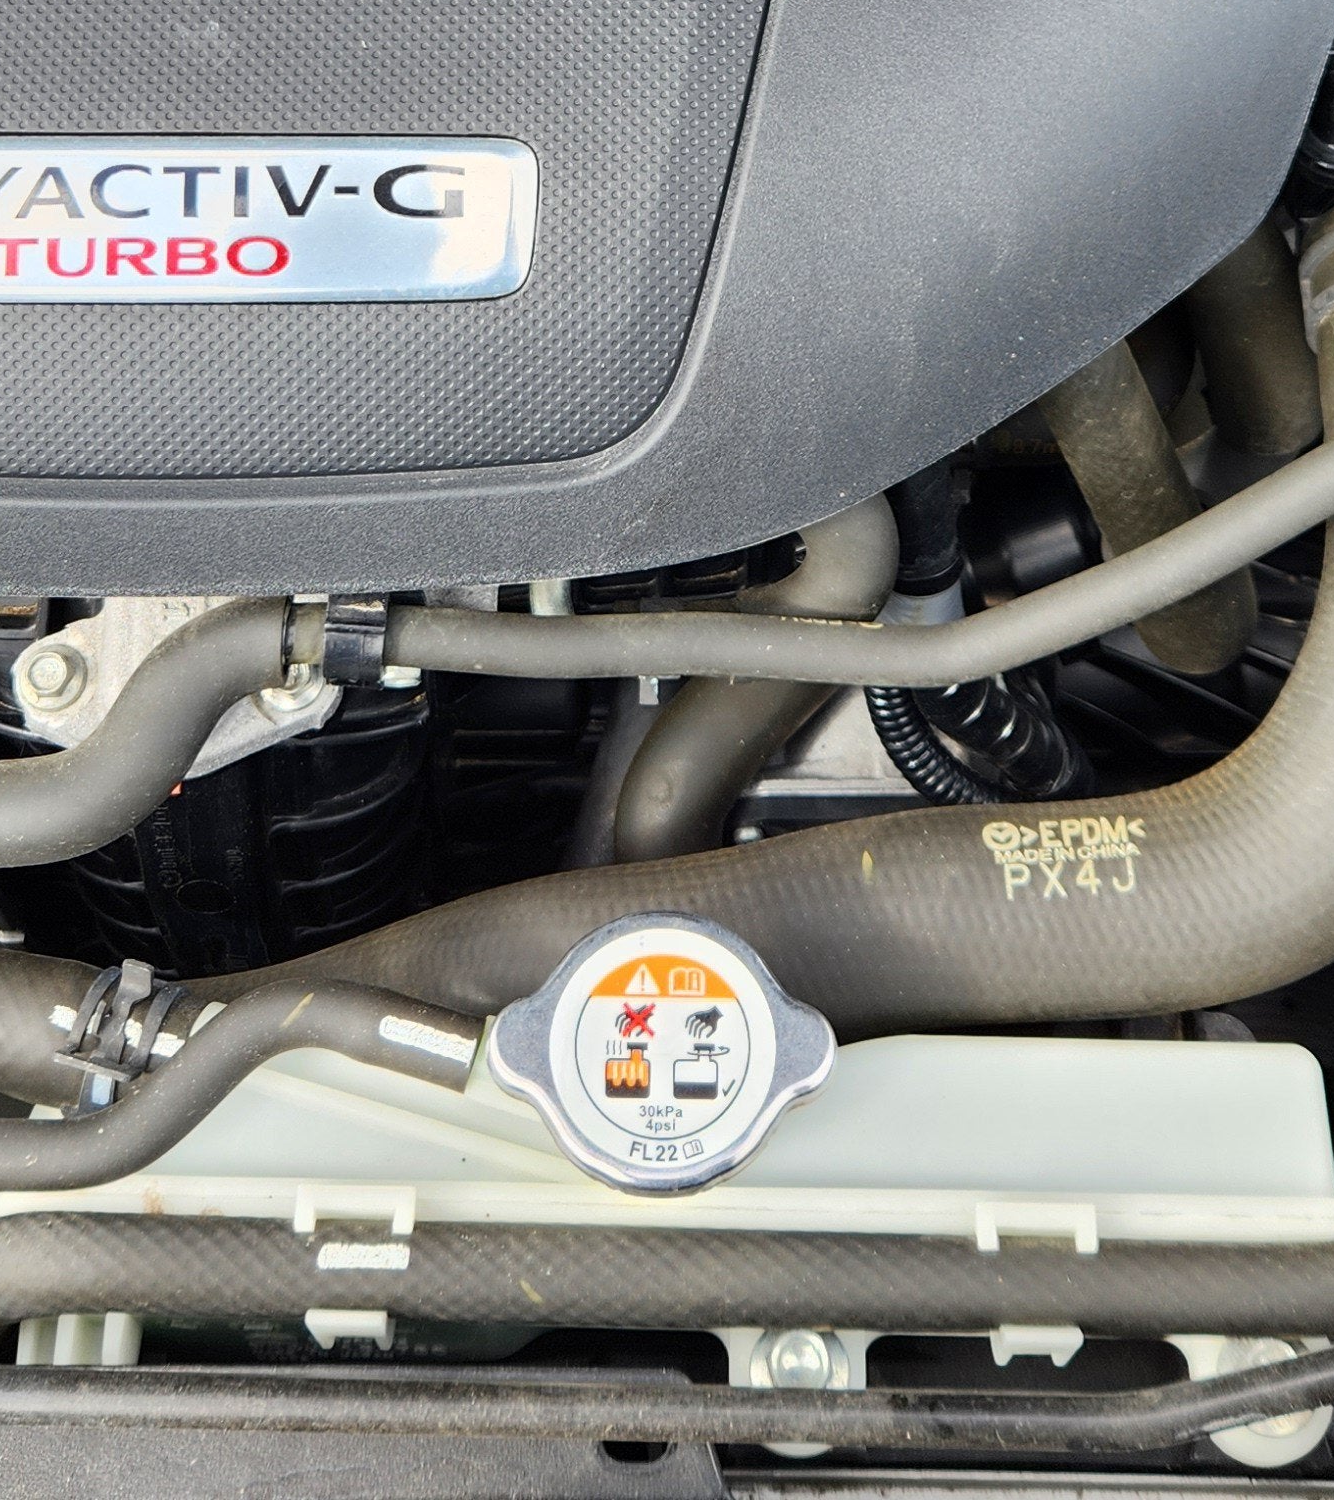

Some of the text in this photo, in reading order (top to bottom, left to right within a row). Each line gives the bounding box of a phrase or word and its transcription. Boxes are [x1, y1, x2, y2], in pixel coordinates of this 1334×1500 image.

[994, 842, 1142, 864] MADE IN CHINA
[639, 1105, 683, 1117] 30kPa
[646, 1120, 676, 1133] 4psi
[629, 1141, 678, 1161] FL22
